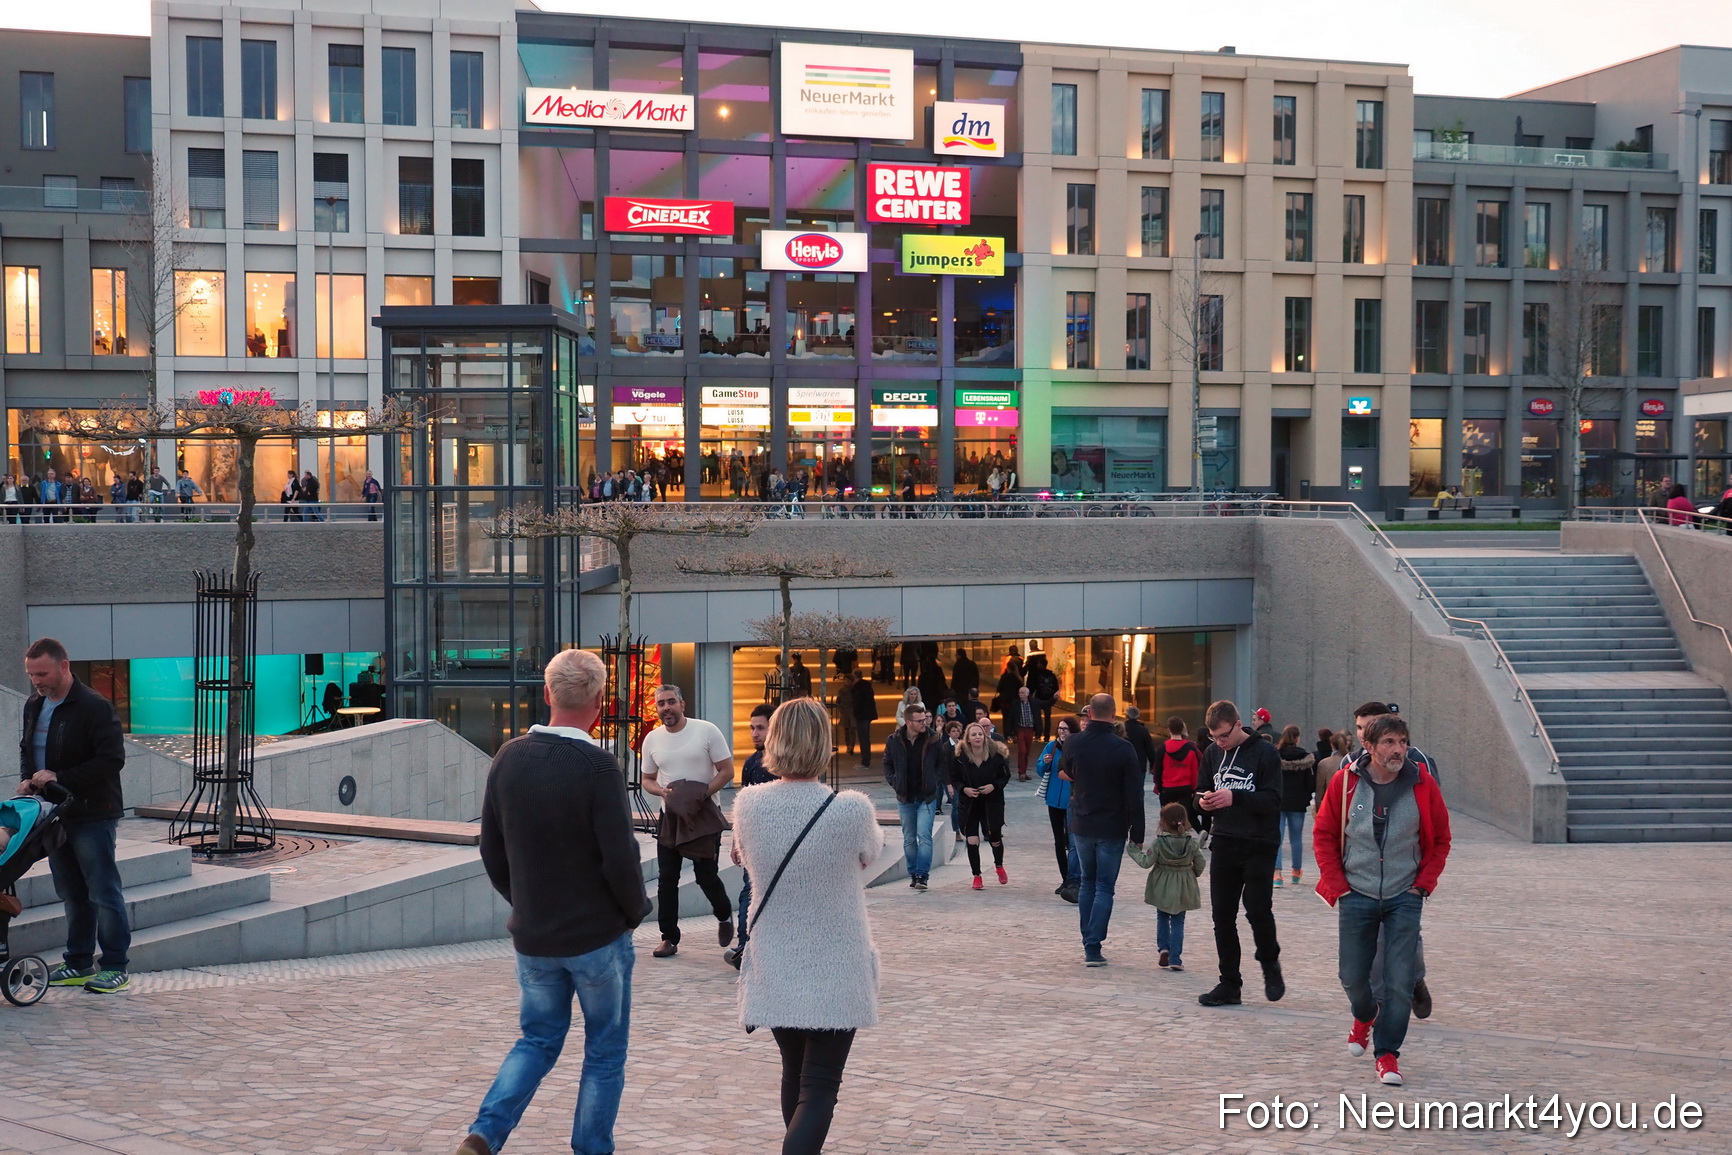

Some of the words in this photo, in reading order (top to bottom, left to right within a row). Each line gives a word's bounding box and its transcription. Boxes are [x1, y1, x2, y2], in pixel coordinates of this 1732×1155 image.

[800, 88, 895, 106] NeuerMarkt
[532, 95, 606, 119] Media
[623, 99, 688, 122] Markt
[952, 112, 991, 136] dm
[875, 168, 962, 198] REWE
[627, 206, 711, 225] CINEPLEX
[875, 198, 962, 220] CENTER
[791, 240, 839, 261] Hervis
[910, 251, 973, 269] jumpers
[646, 337, 679, 345] HILLSIDE
[632, 391, 666, 399] Vögele
[712, 389, 759, 399] GameStop
[796, 389, 840, 398] Spielwaren
[883, 392, 928, 400] DEPOT
[1111, 471, 1156, 479] NeuerMarkt
